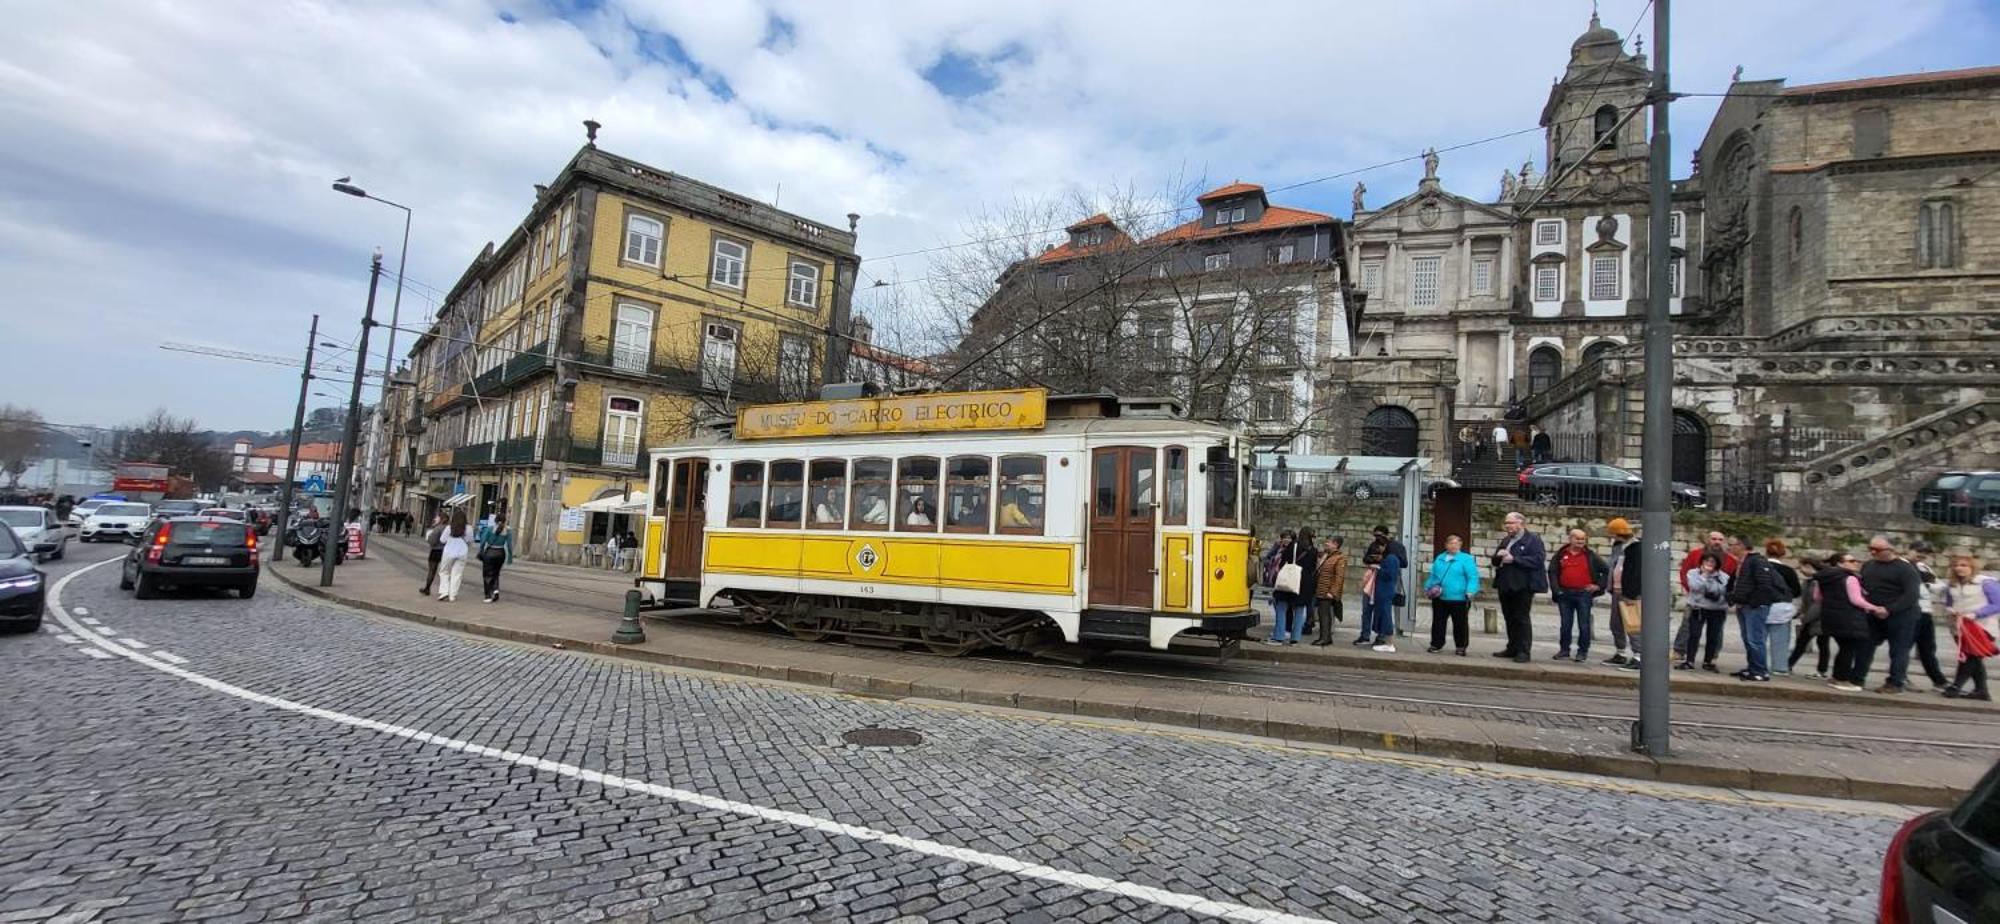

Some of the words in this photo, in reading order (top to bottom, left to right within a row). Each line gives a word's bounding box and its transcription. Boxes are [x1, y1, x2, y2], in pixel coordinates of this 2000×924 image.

[760, 411, 805, 428] MUSEU
[816, 411, 836, 425] DO
[847, 407, 903, 424] CARRO
[1215, 554, 1228, 563] 143
[860, 586, 874, 594] 143
